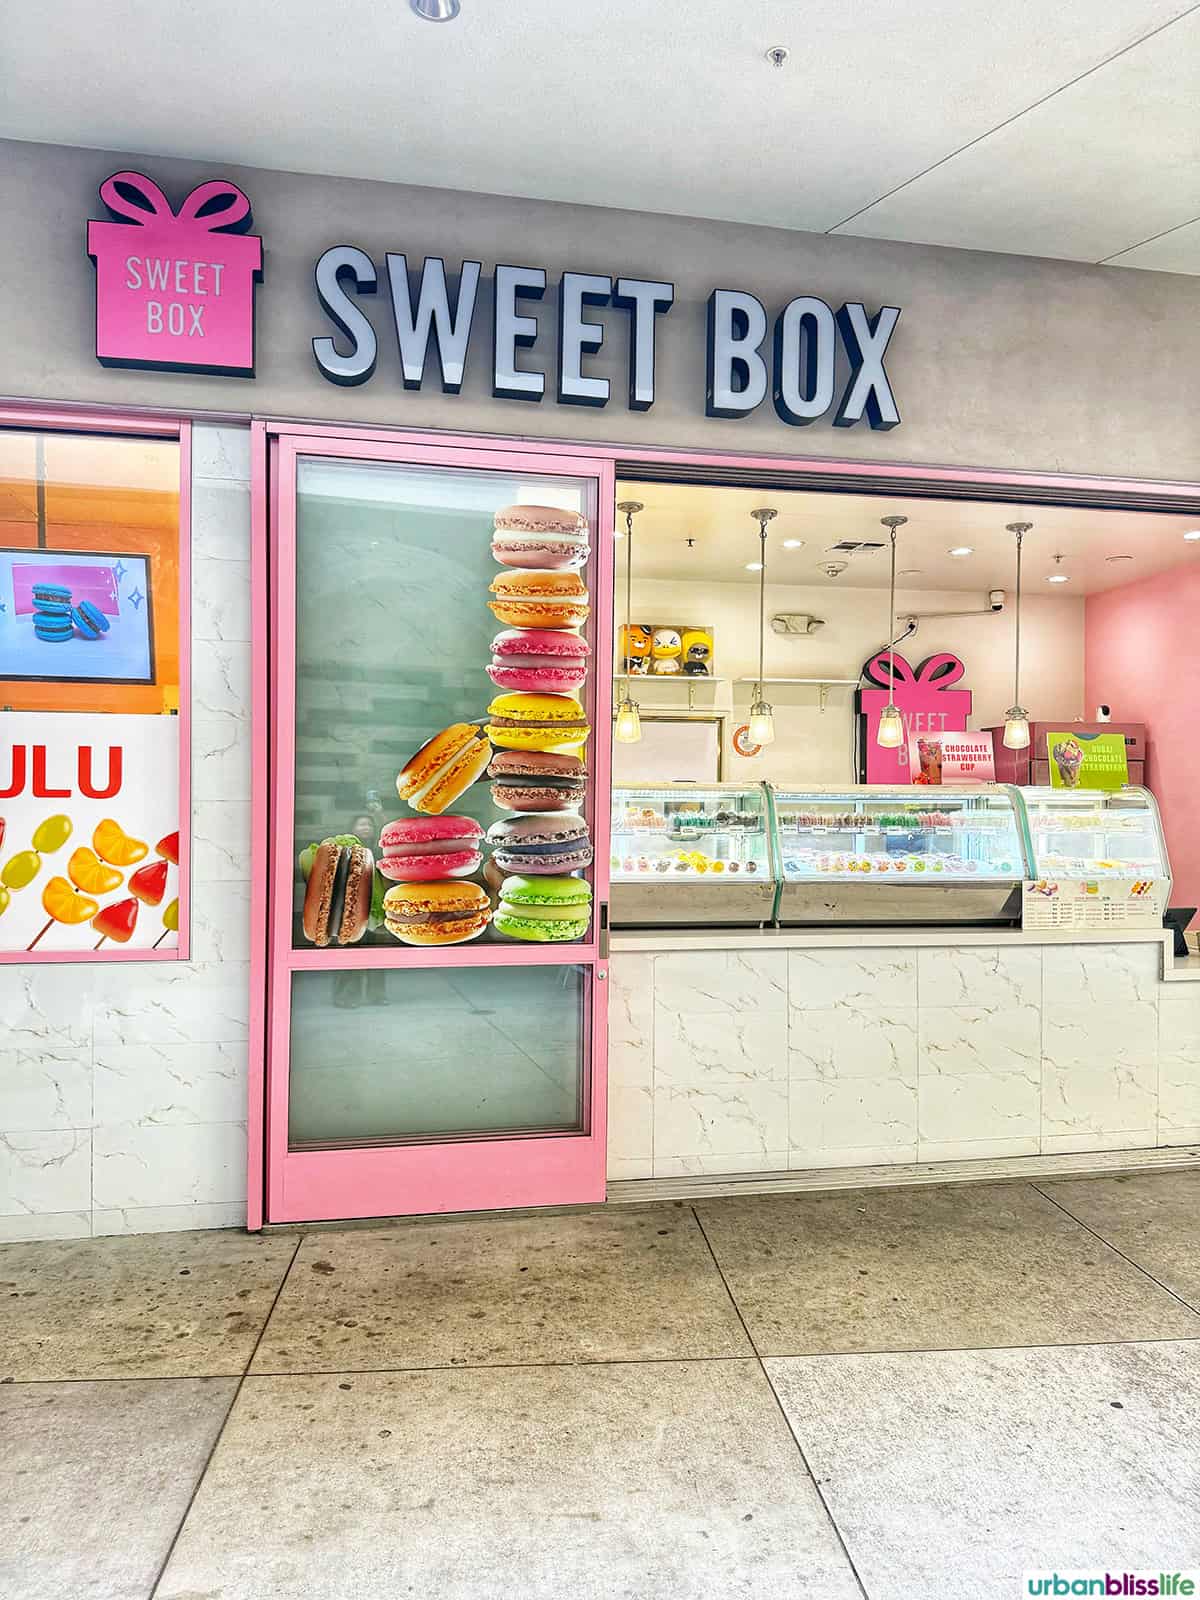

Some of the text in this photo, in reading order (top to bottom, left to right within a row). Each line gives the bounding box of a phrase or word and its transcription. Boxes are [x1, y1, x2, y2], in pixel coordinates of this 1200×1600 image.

[126, 256, 225, 296] SWEET
[147, 301, 205, 337] BOX
[311, 245, 901, 429] SWEET BOX
[944, 744, 988, 753] CHOCOLATE
[942, 753, 992, 762] STRAWBERRY
[1084, 754, 1122, 763] CHOCOLATE
[960, 763, 975, 771] CUP
